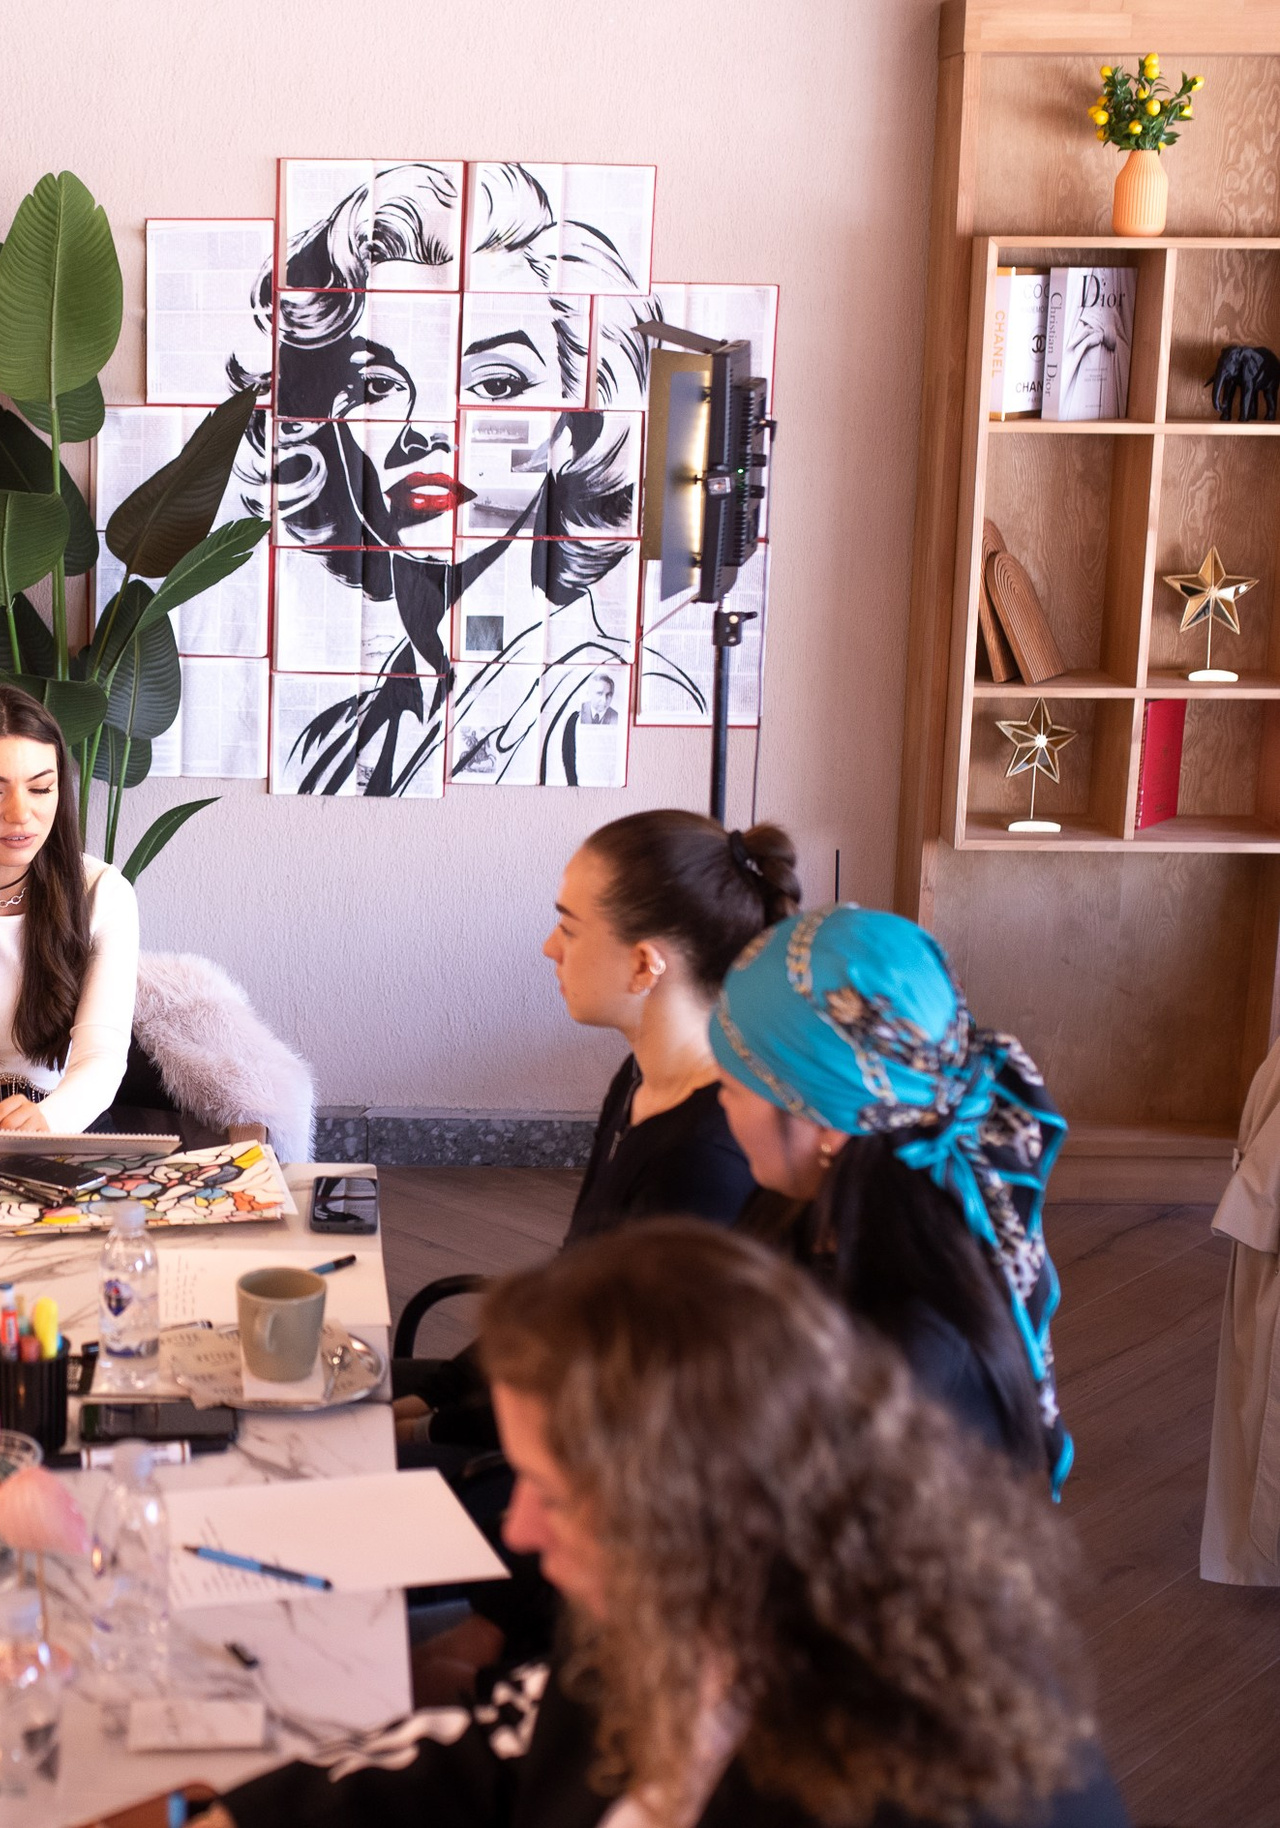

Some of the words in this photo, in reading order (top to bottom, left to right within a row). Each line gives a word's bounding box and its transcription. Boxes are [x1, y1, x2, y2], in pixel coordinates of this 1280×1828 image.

[1023, 283, 1050, 300] COC
[1079, 275, 1125, 308] Dior
[1048, 292, 1062, 354] Christian
[992, 310, 1006, 378] CHANEL
[1015, 380, 1043, 394] CHAN
[1045, 363, 1057, 397] Dior
